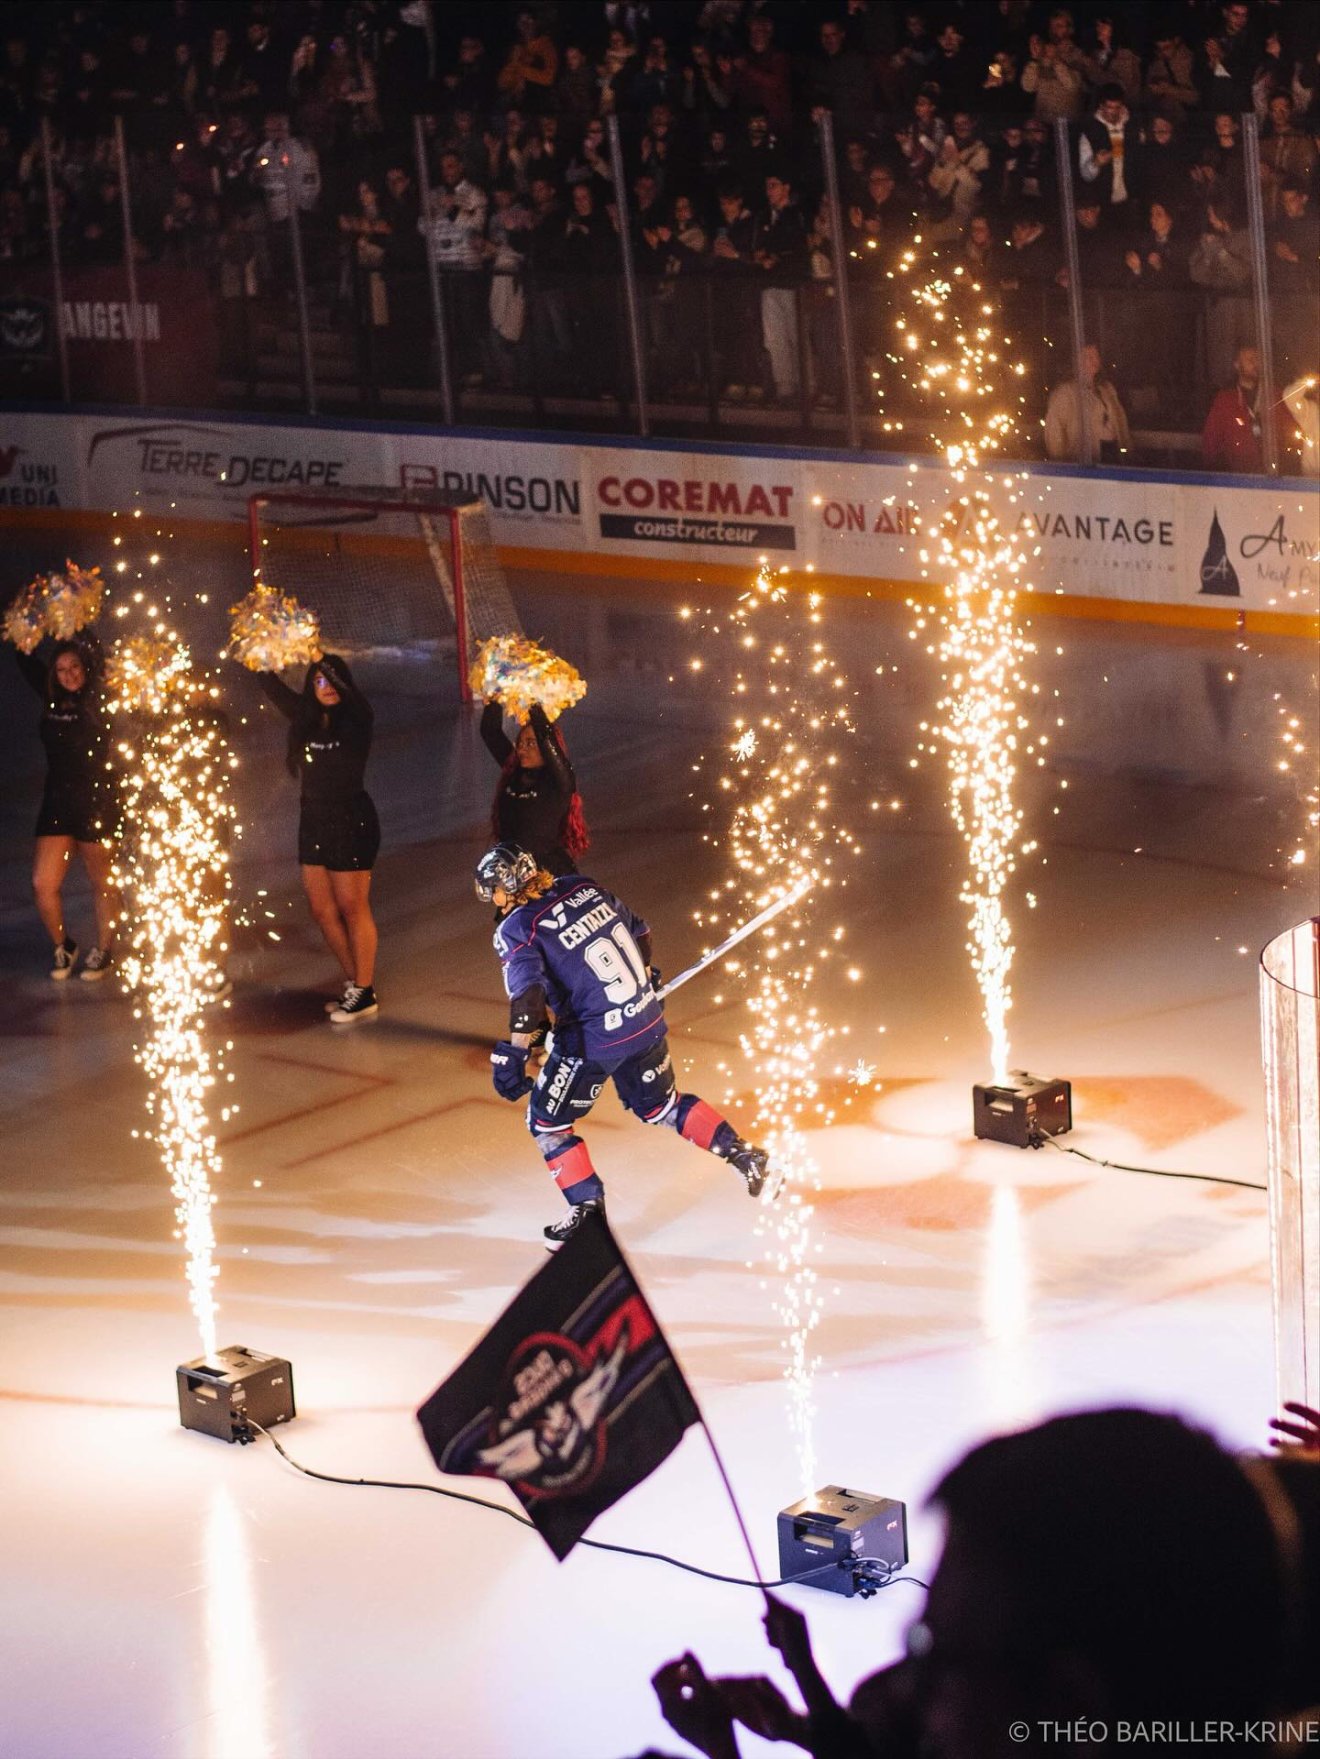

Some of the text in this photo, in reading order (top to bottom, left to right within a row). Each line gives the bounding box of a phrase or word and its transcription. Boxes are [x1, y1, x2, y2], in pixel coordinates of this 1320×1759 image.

[137, 439, 219, 476] TERRE
[598, 476, 793, 517] COREMAT
[634, 517, 758, 543] constructeur
[823, 502, 866, 532] ON
[1015, 511, 1174, 546] AVANTAGE
[564, 887, 599, 908] Vallée
[584, 921, 647, 1005] 91
[548, 1062, 571, 1099] BON
[546, 1098, 556, 1114] AU
